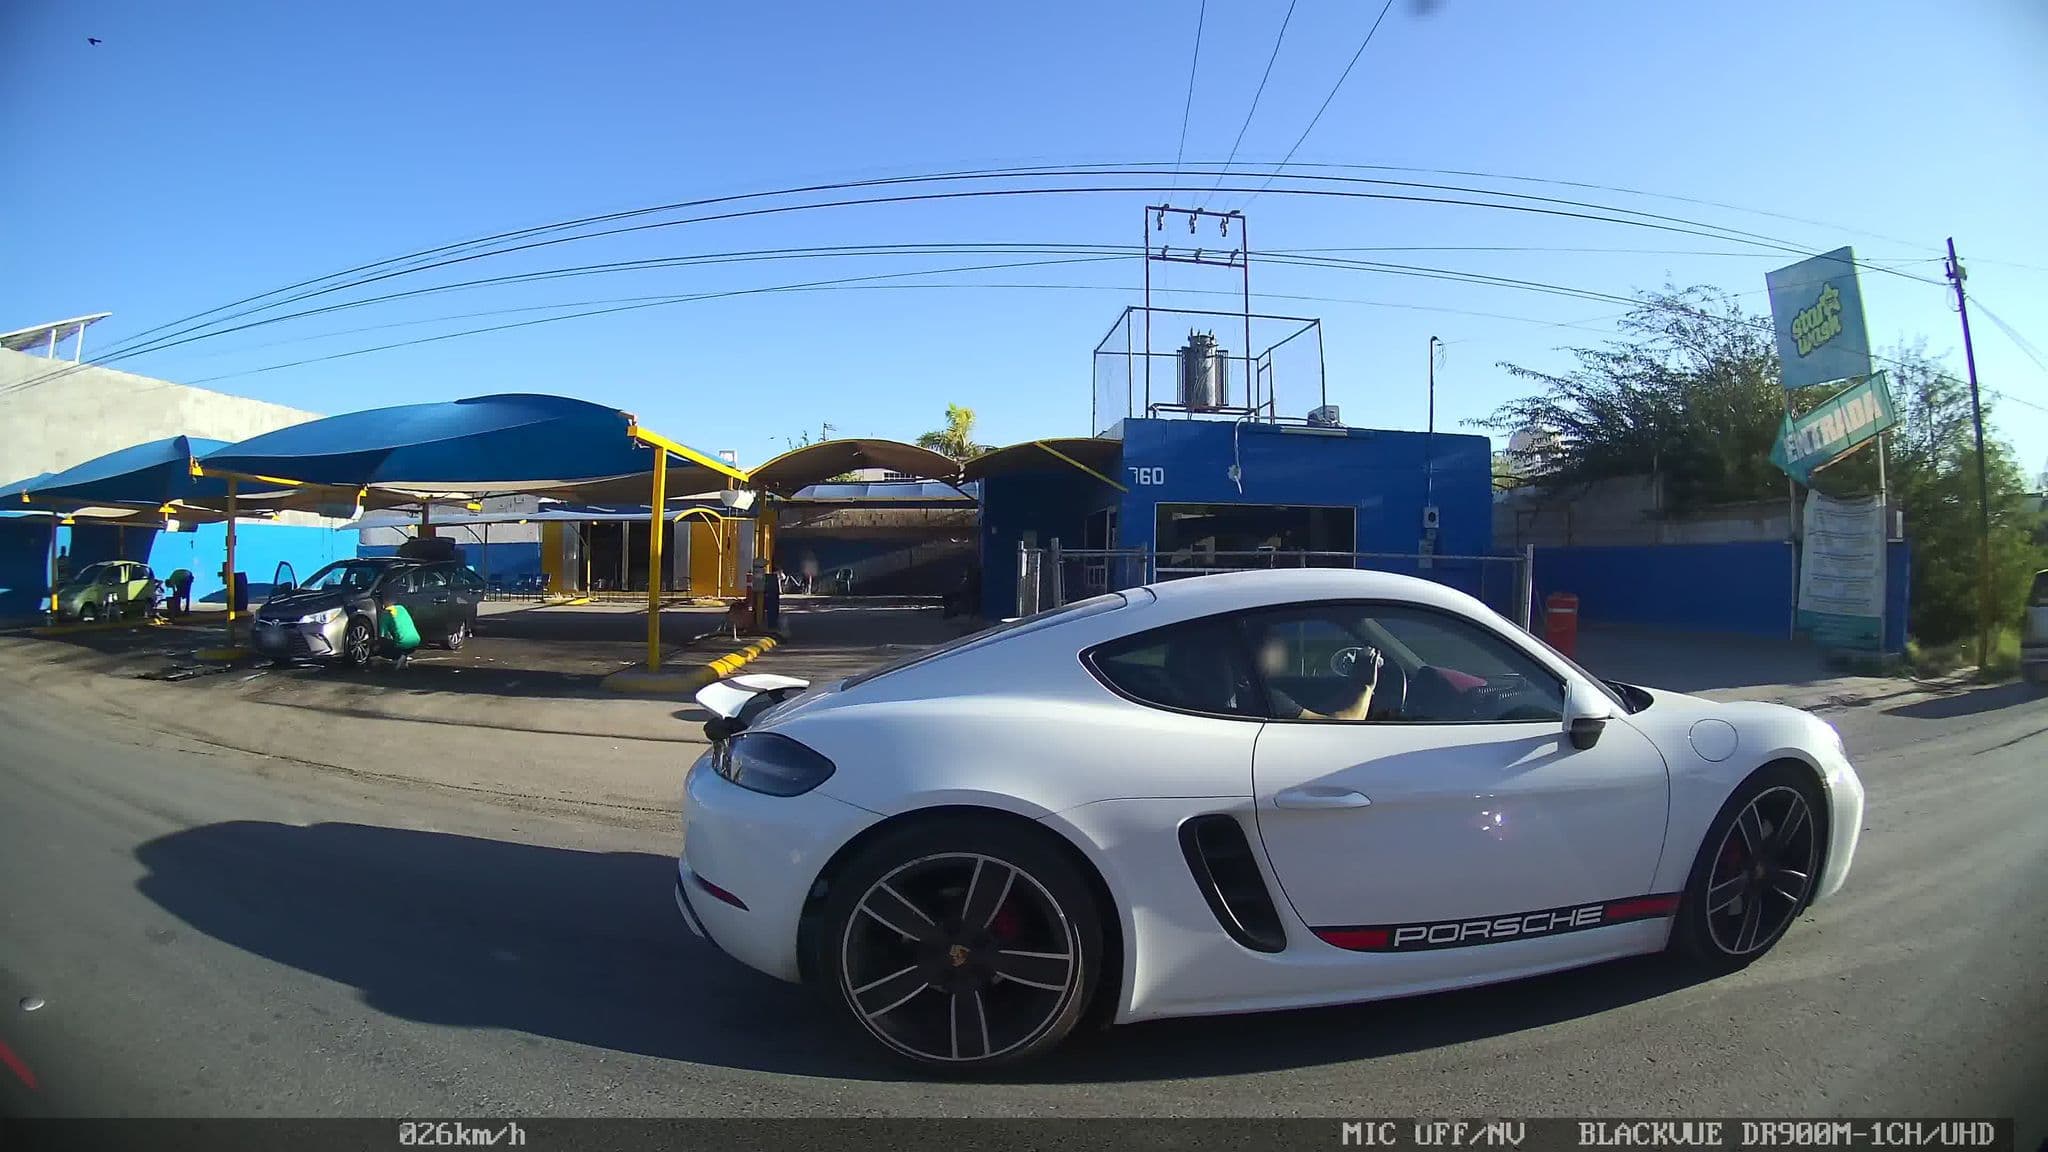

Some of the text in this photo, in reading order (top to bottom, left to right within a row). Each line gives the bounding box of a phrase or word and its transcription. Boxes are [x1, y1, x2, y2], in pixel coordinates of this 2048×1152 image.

[1783, 391, 1882, 465] ENTRADA
[1127, 467, 1165, 485] 760
[1394, 905, 1604, 947] PORSCHE
